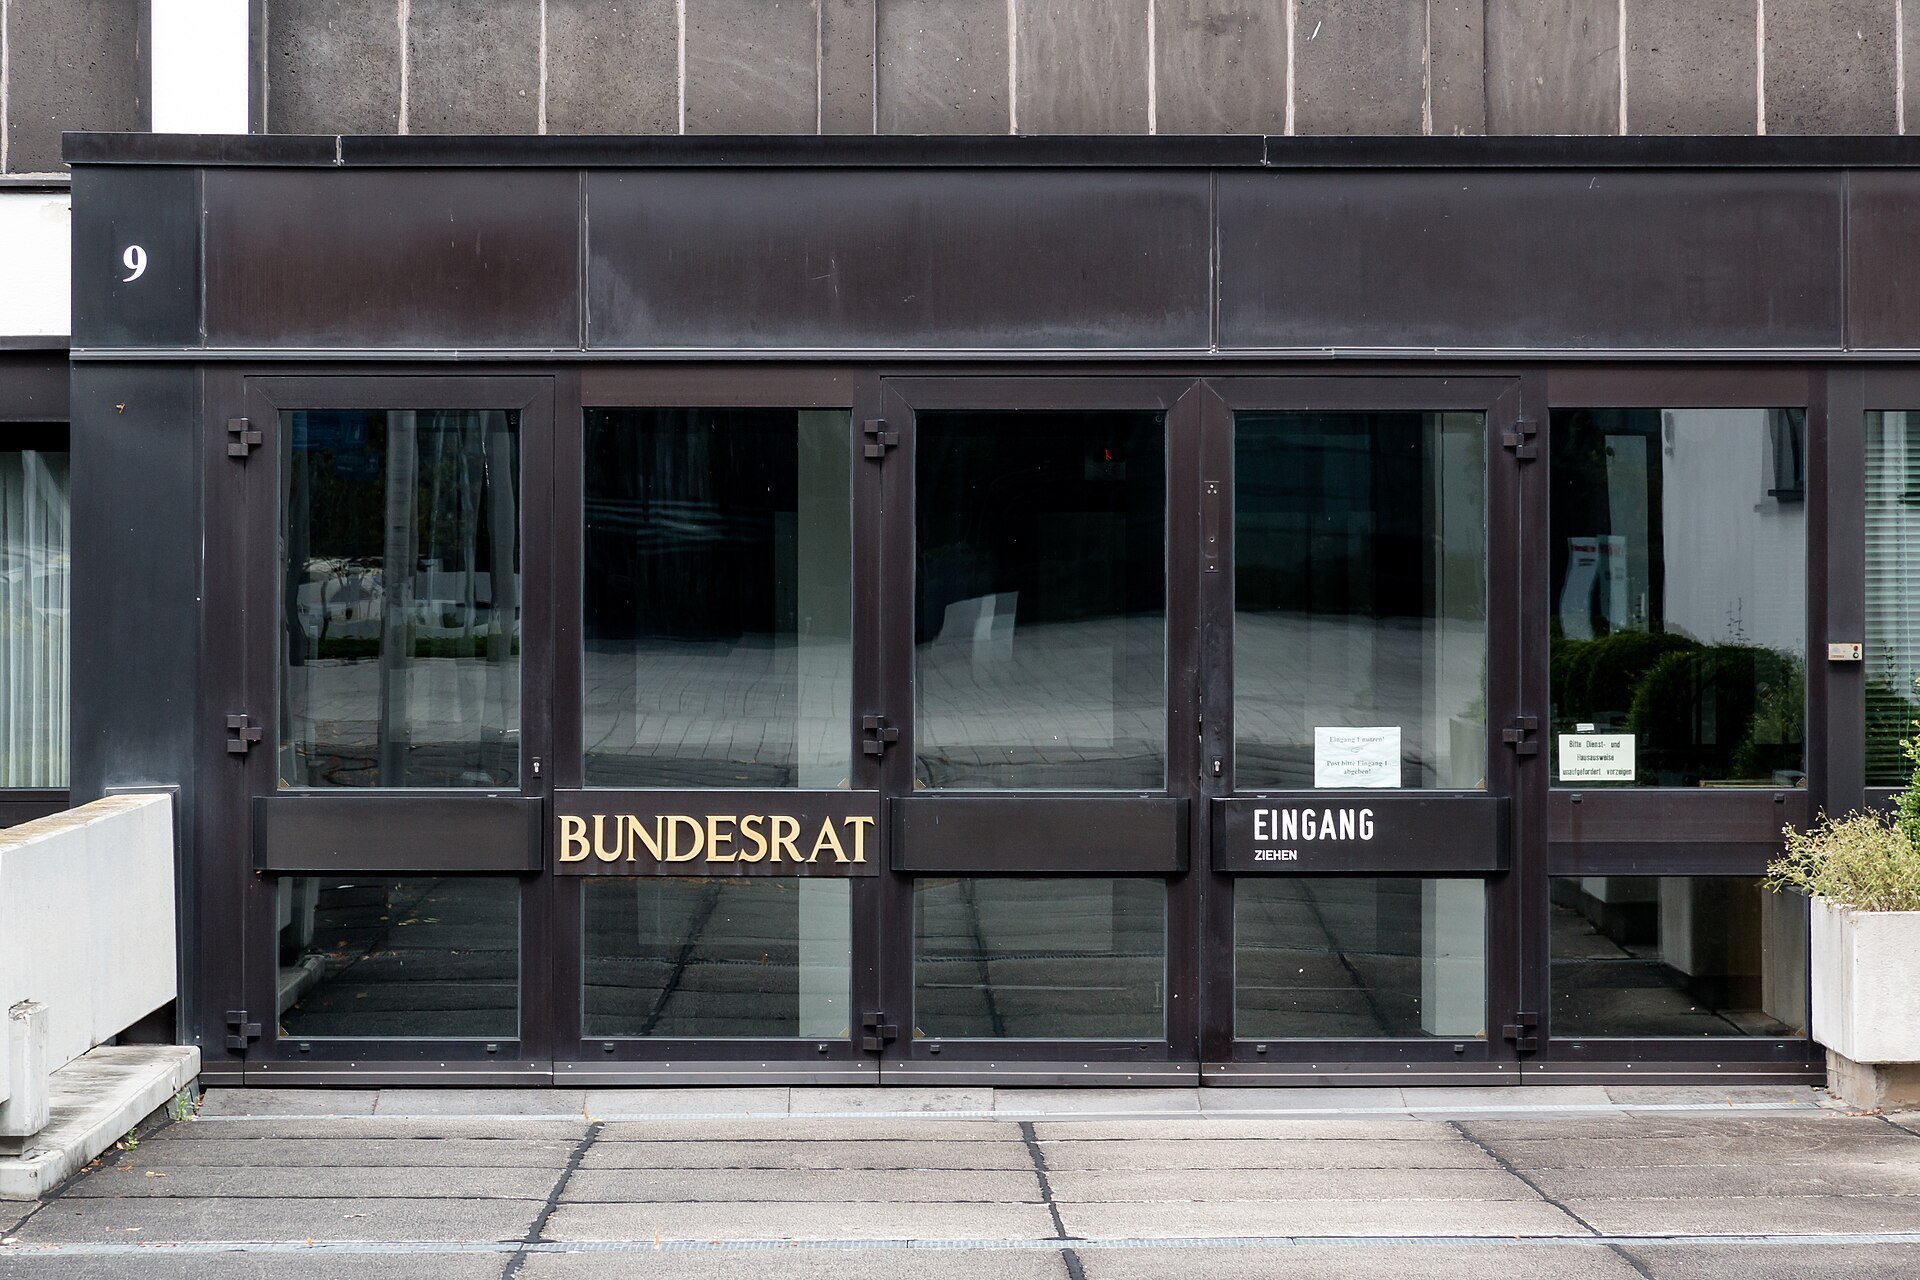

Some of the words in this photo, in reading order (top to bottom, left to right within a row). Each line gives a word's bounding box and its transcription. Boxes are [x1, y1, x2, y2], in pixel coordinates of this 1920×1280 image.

[122, 244, 148, 282] 9
[558, 814, 874, 863] BUNDESRAT
[1254, 808, 1374, 841] EINGANG
[1254, 849, 1298, 860] ZIEHEN
